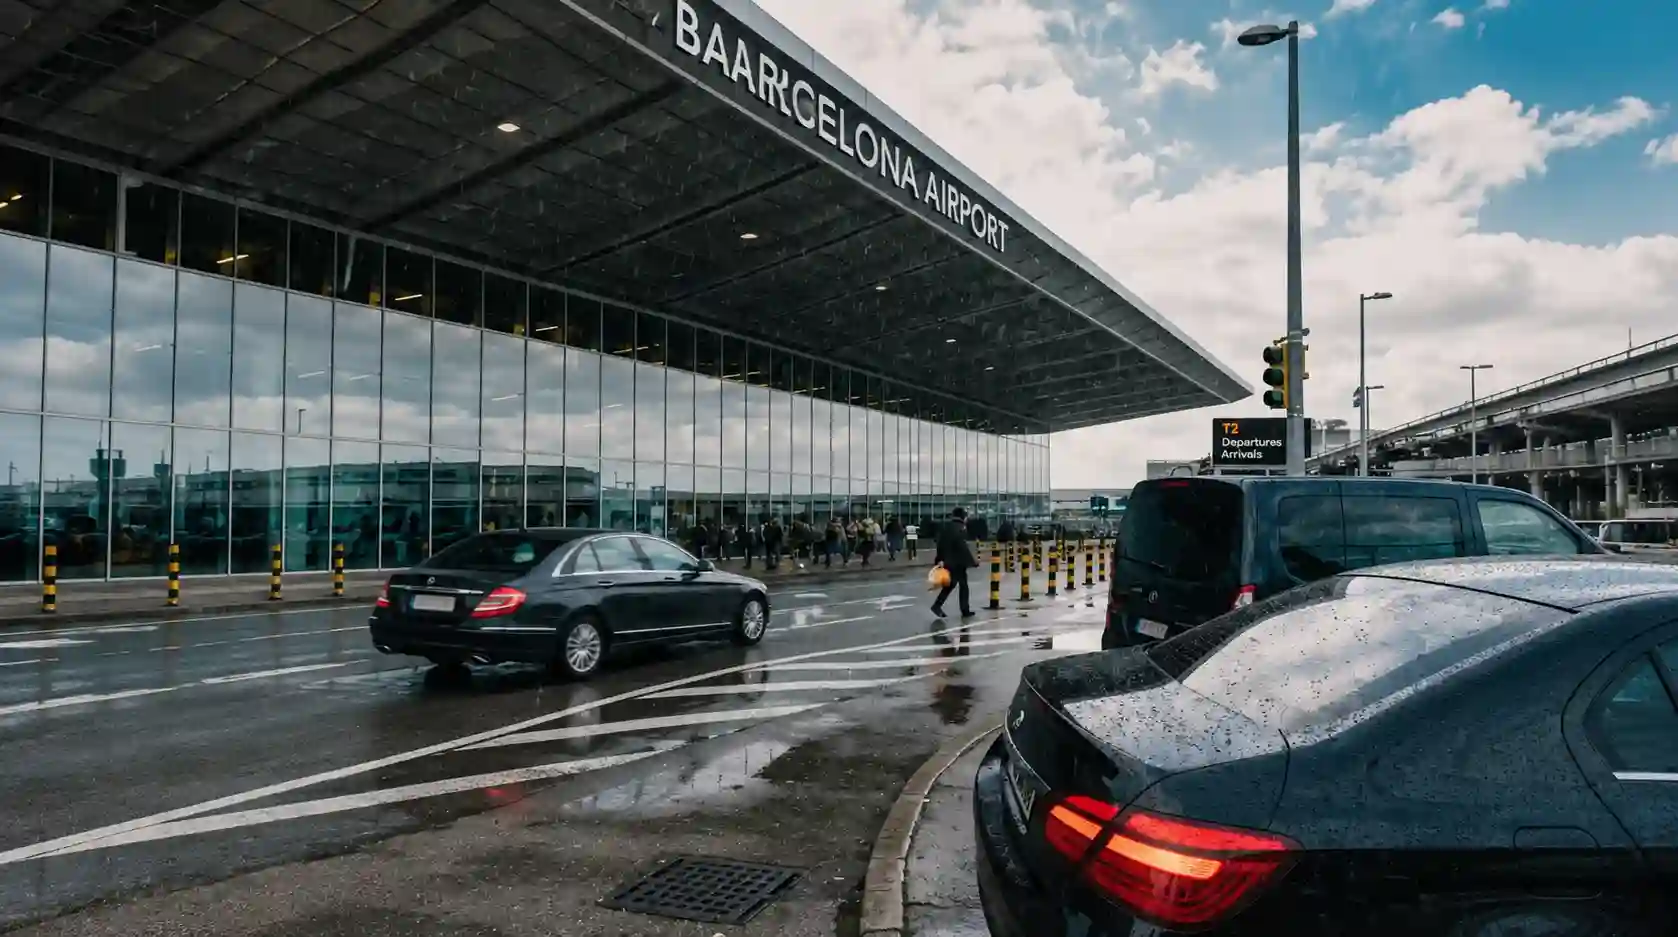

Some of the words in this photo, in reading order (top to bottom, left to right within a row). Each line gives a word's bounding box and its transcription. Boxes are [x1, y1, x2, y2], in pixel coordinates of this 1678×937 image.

[924, 171, 1009, 252] AIRPORT
[1222, 422, 1239, 434] T2
[1222, 437, 1282, 448] Departures
[1221, 449, 1263, 459] Arrivals
